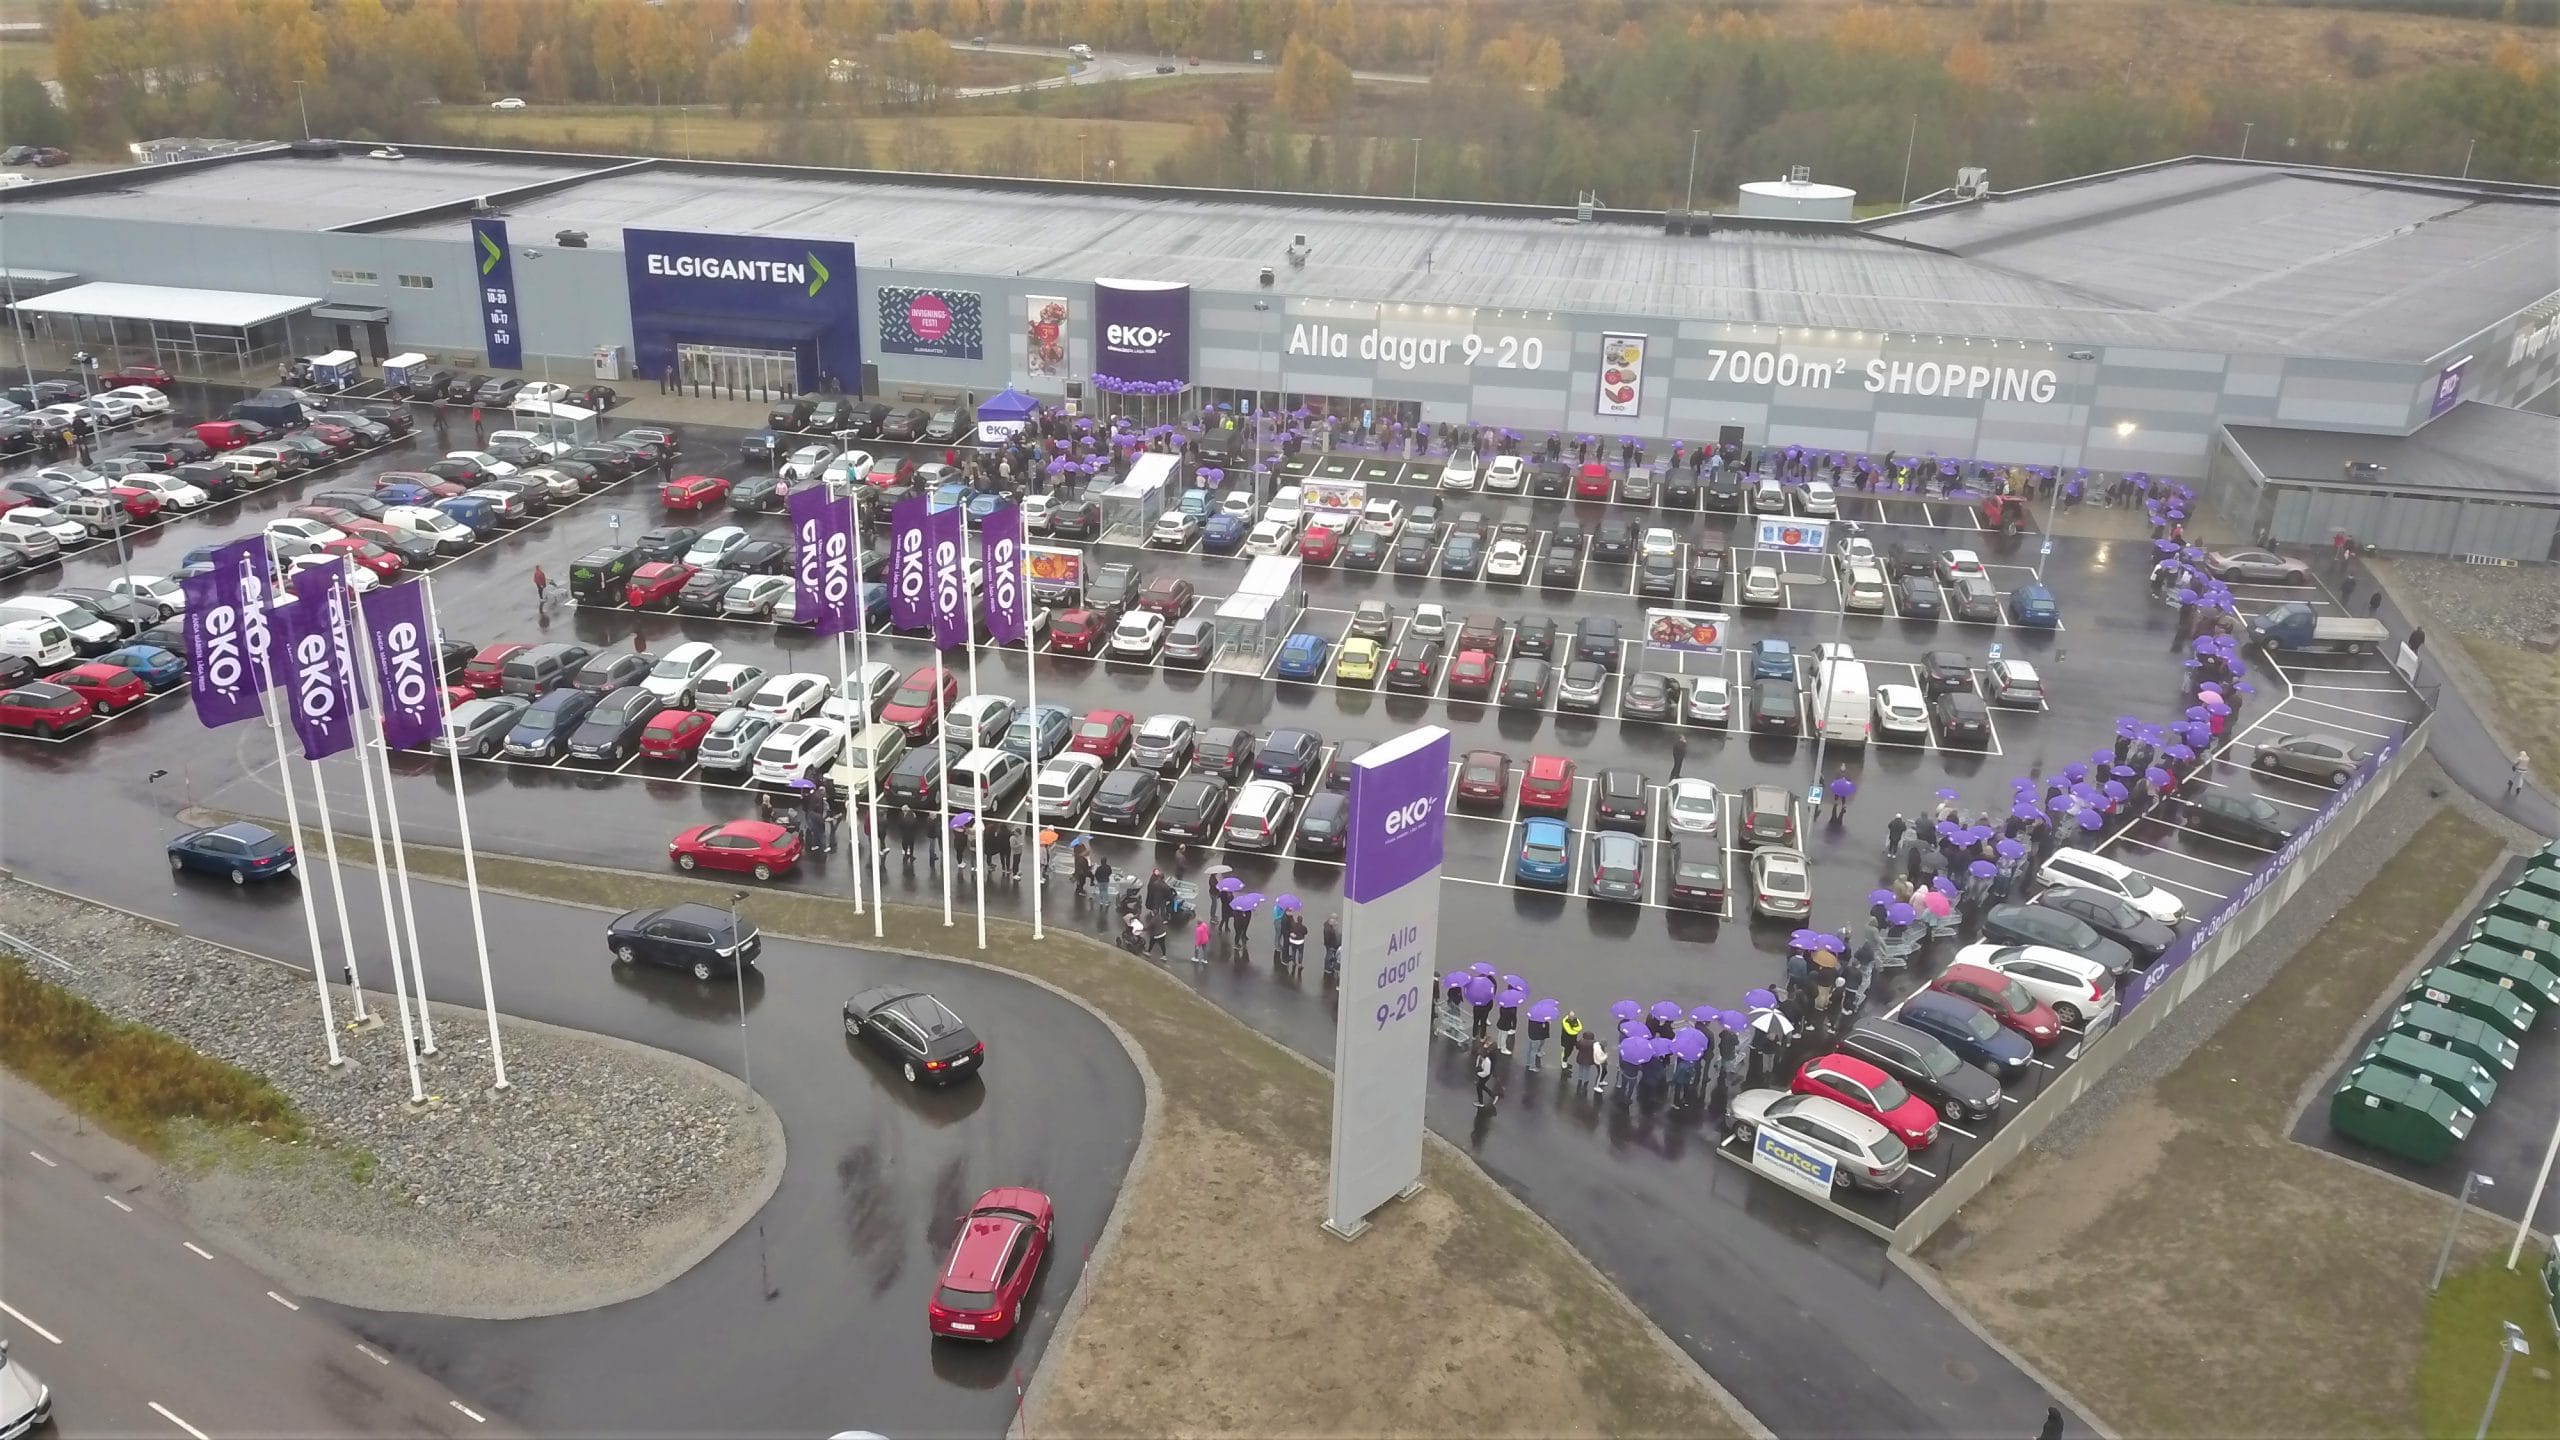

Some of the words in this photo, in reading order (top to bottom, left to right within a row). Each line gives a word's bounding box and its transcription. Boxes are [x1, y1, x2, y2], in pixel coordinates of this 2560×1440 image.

[648, 254, 805, 285] ELGIGANTEN
[1107, 324, 1157, 347] eko
[1289, 324, 1349, 359] Alla
[1360, 329, 1451, 370] dagar
[1463, 334, 1542, 370] 9-20
[1864, 359, 2057, 404] SHOPPING
[986, 425, 1009, 436] eko
[824, 532, 848, 602] eko
[902, 528, 924, 599] eko
[936, 541, 958, 614] eko
[994, 538, 1016, 609] eko
[205, 605, 242, 687] eko
[388, 622, 426, 705] eko
[297, 634, 335, 717] eko
[1385, 797, 1429, 835] eko
[1387, 925, 1417, 956] Alla
[1377, 950, 1422, 989] dagar
[1376, 986, 1418, 1031] 9-20
[1764, 1139, 1821, 1177] Fastec
